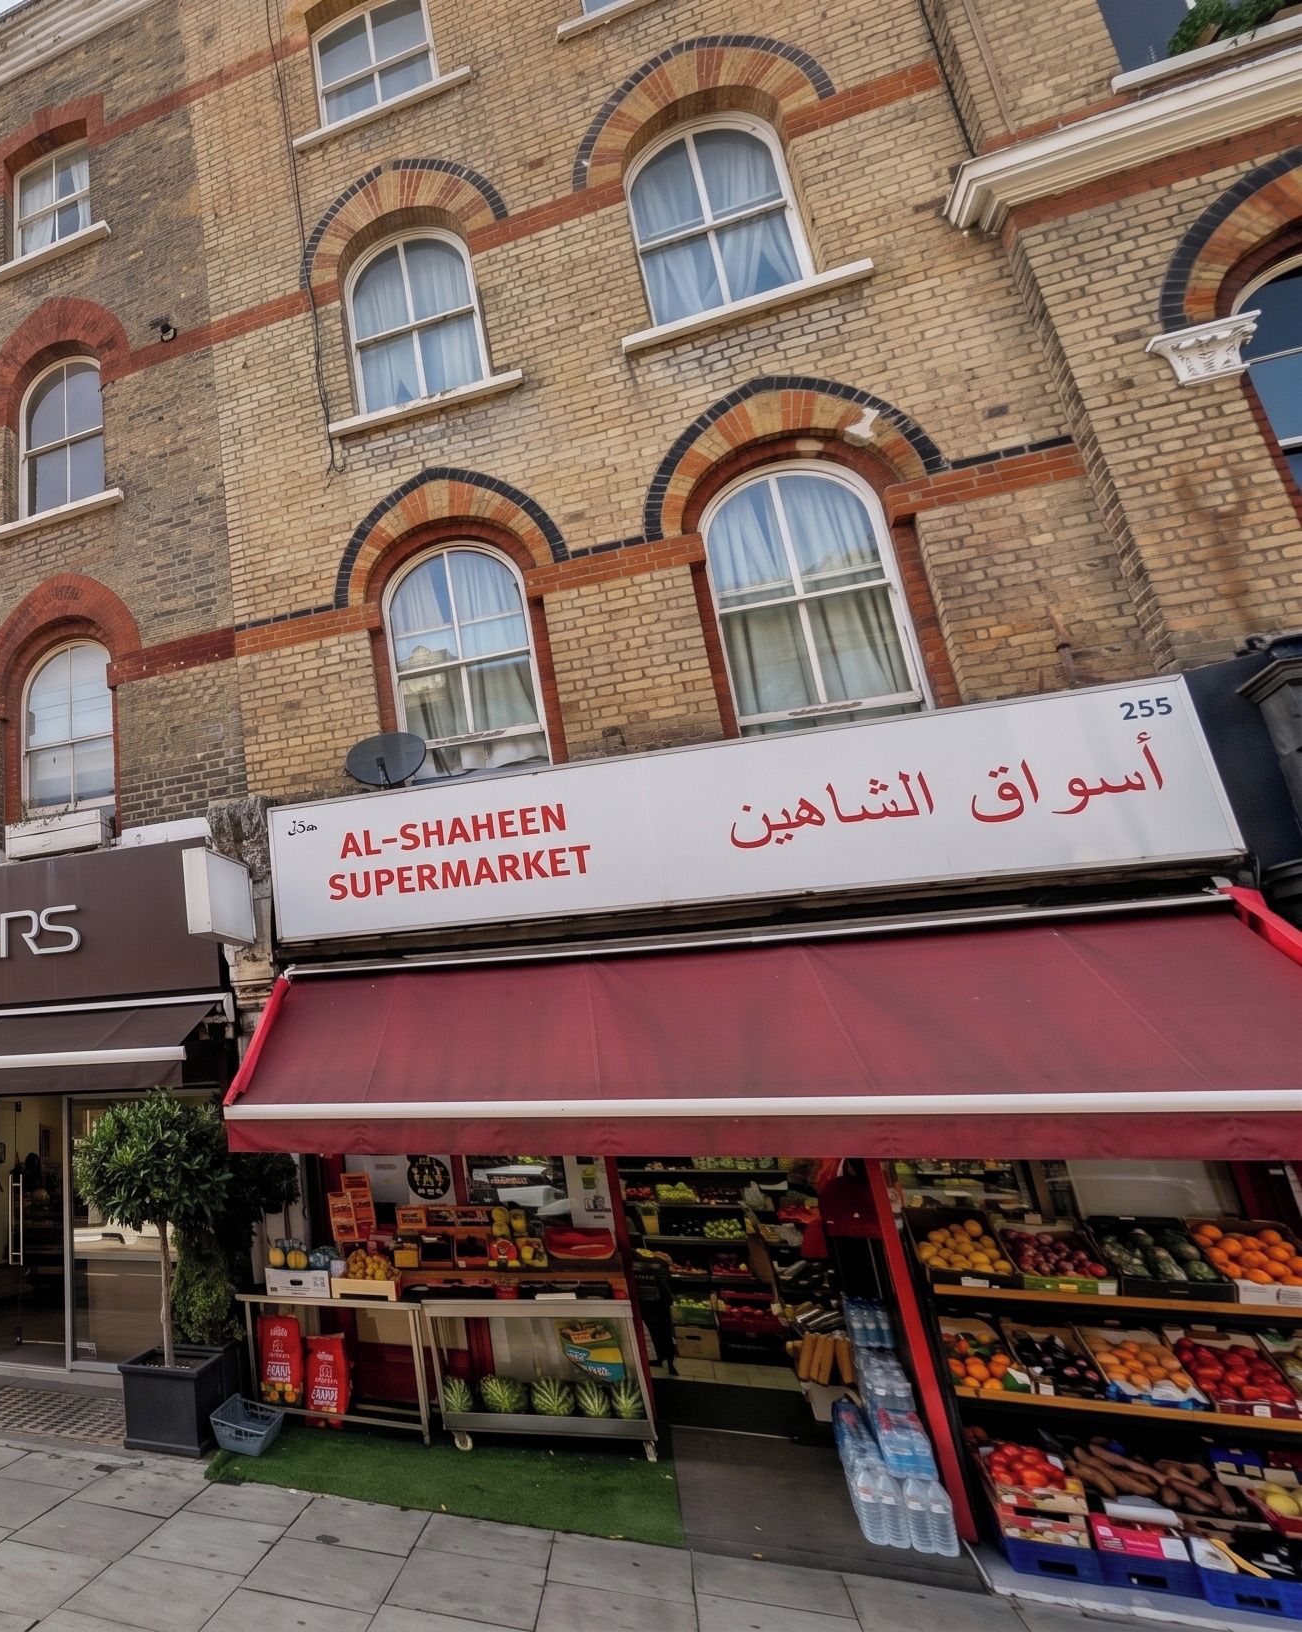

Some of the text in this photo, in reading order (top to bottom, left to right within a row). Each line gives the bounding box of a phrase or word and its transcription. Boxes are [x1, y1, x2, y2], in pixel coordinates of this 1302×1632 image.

[1120, 696, 1173, 721] 255
[730, 731, 1164, 850] أسواق الشاهين
[340, 803, 567, 860] AL-SHAHEEN
[328, 844, 591, 901] SUPERMARKET
